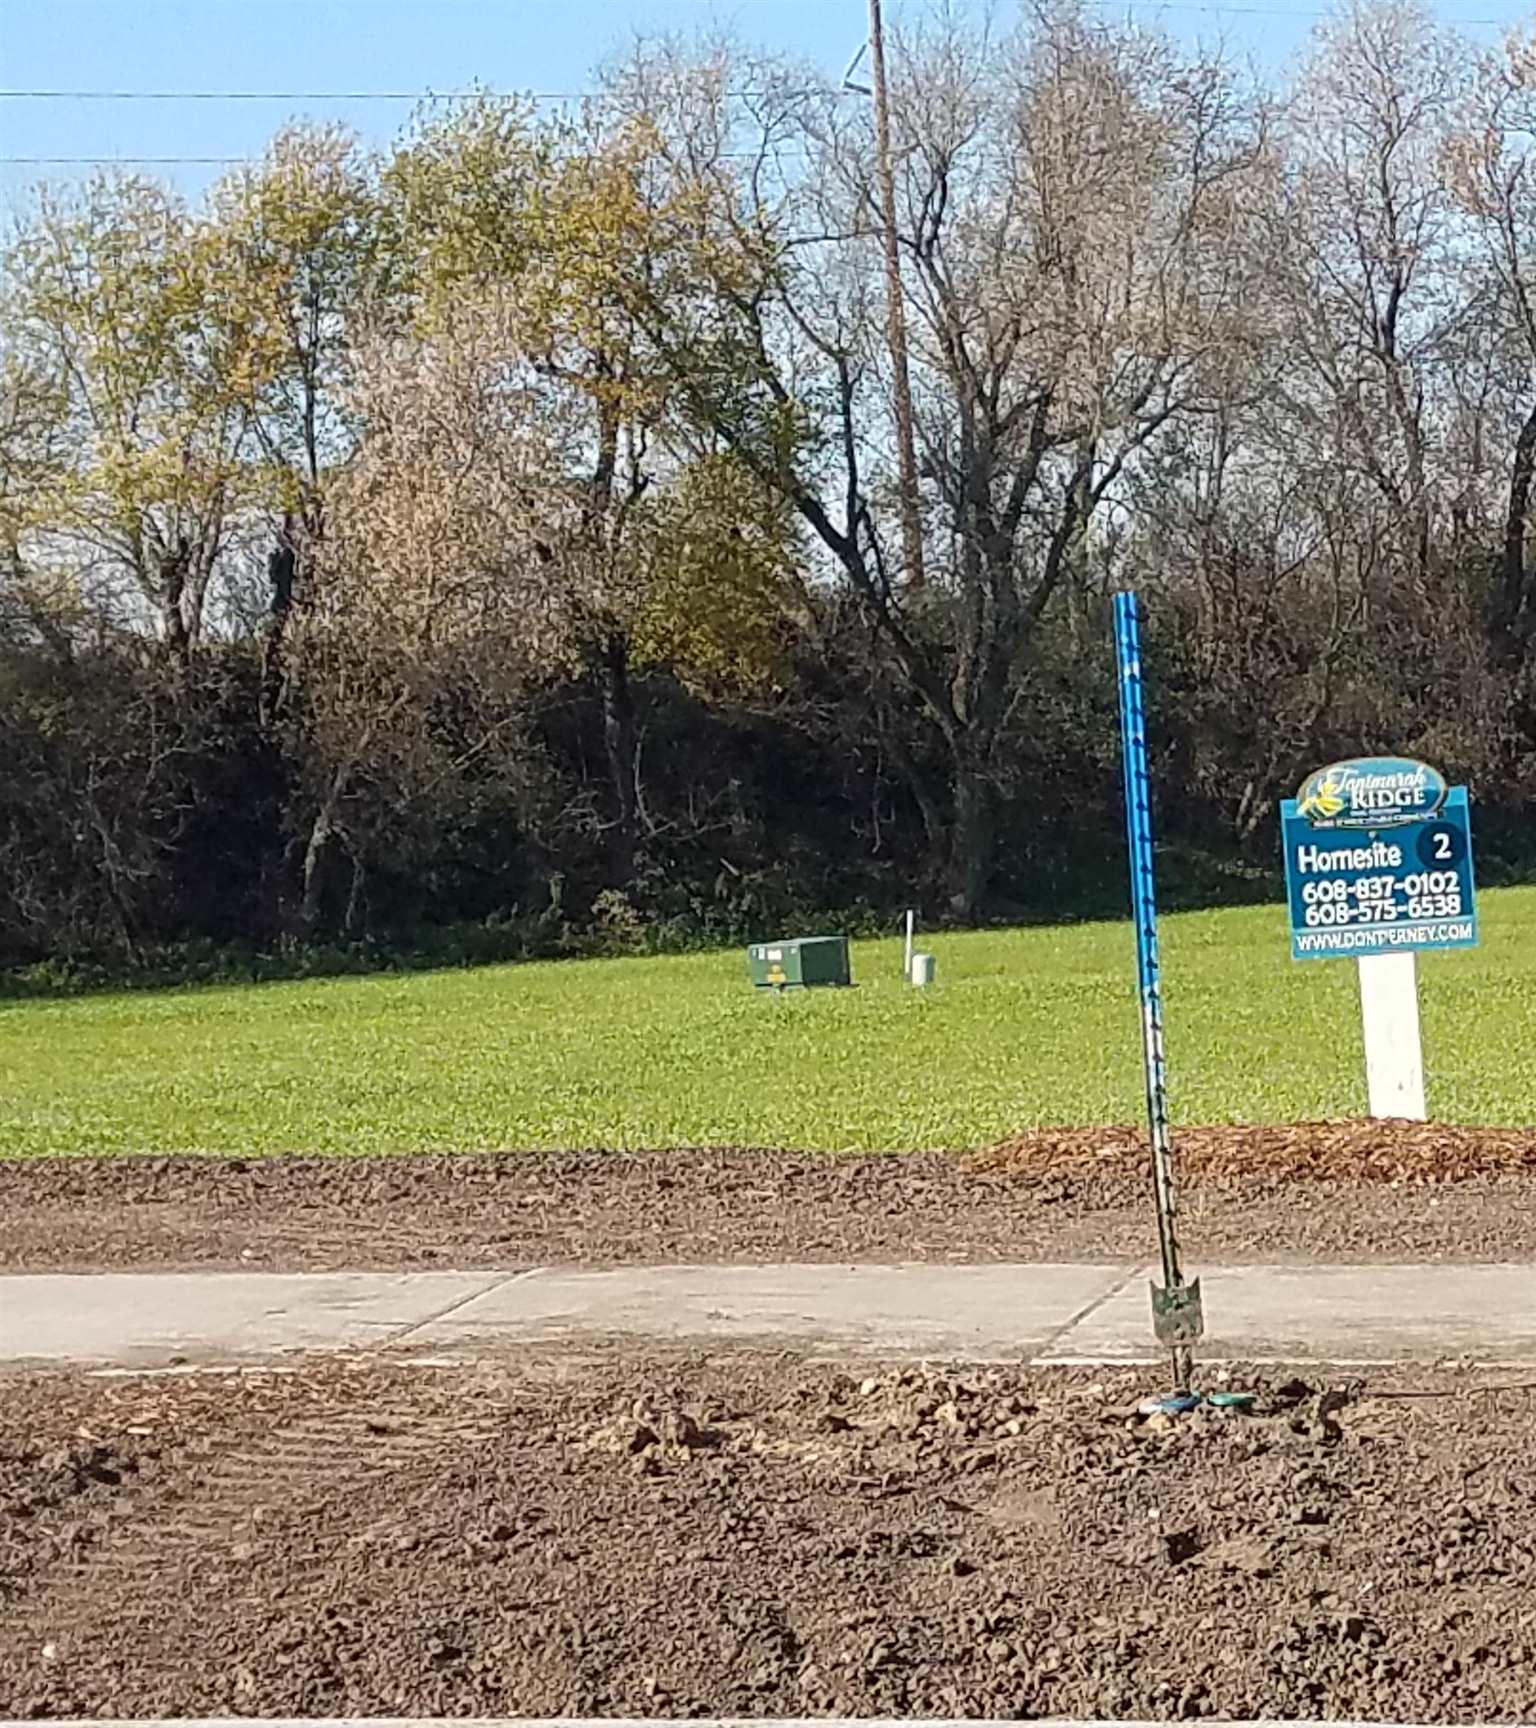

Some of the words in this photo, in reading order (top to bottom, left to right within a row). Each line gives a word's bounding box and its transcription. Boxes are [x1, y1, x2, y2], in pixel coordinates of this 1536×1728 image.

[1350, 787, 1427, 811] RIDGE
[1298, 842, 1402, 873] Homesite
[1432, 833, 1453, 859] 2
[1302, 871, 1461, 904] 608-837-0102
[1305, 894, 1462, 926] 608-575-6538
